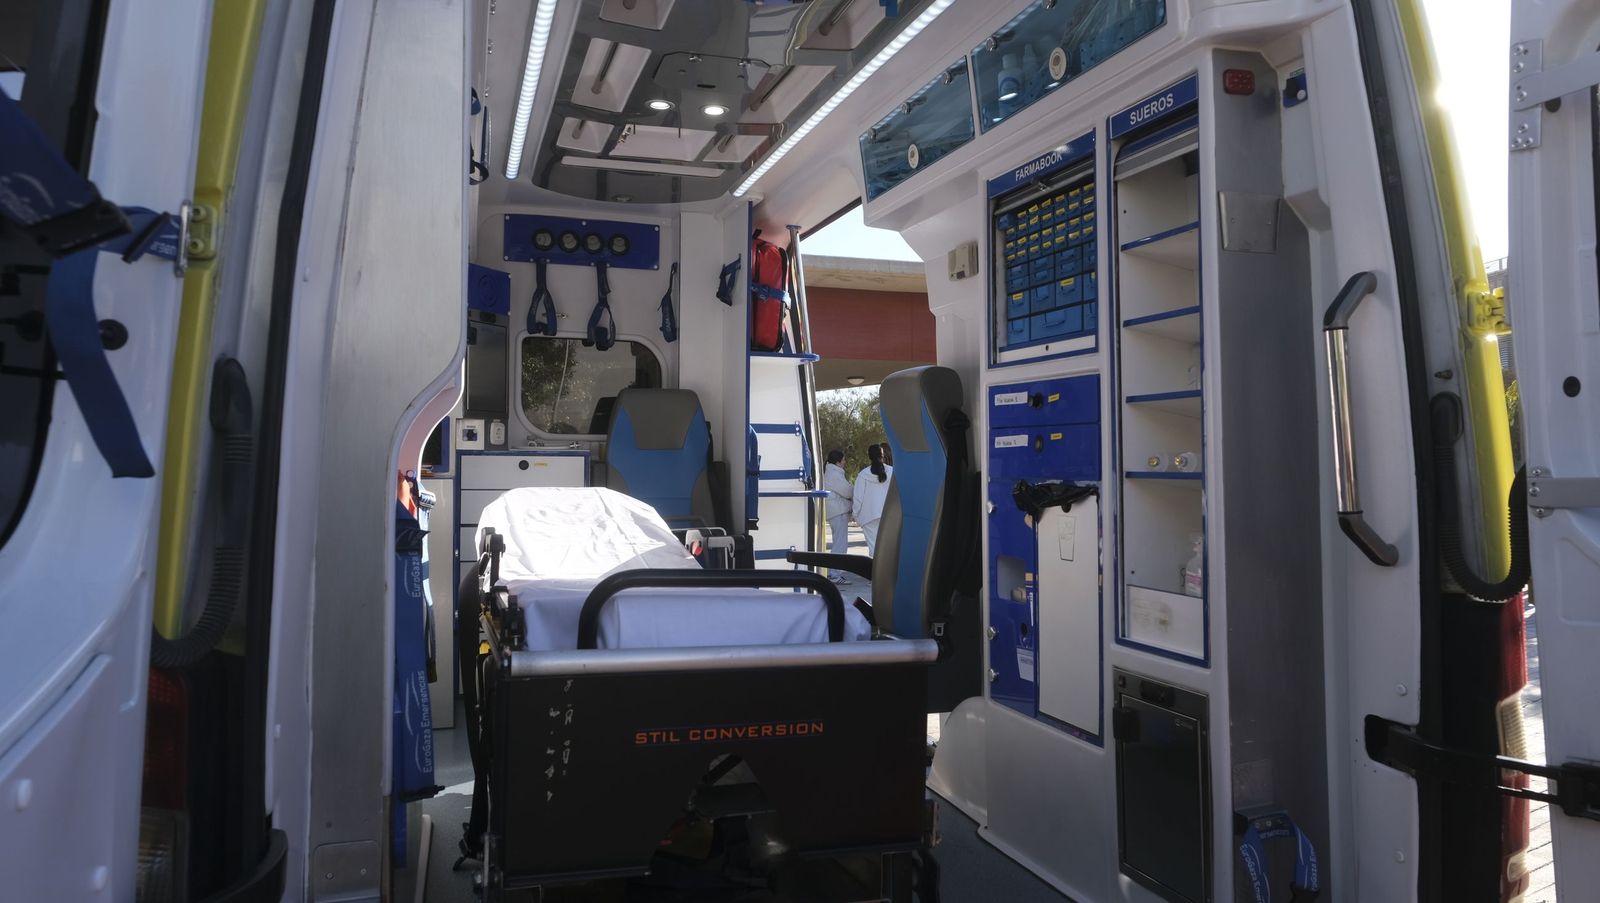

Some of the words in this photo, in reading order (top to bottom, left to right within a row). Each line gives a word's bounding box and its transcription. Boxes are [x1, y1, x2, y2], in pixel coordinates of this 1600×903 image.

[1129, 93, 1174, 125] SUEROS
[1015, 150, 1063, 182] FARMABOOK
[411, 556, 421, 598] EuroGaza
[418, 670, 430, 727] Emergencias
[422, 728, 433, 773] EuroGaza
[635, 730, 680, 744] STIL
[689, 722, 824, 741] CONVERSION
